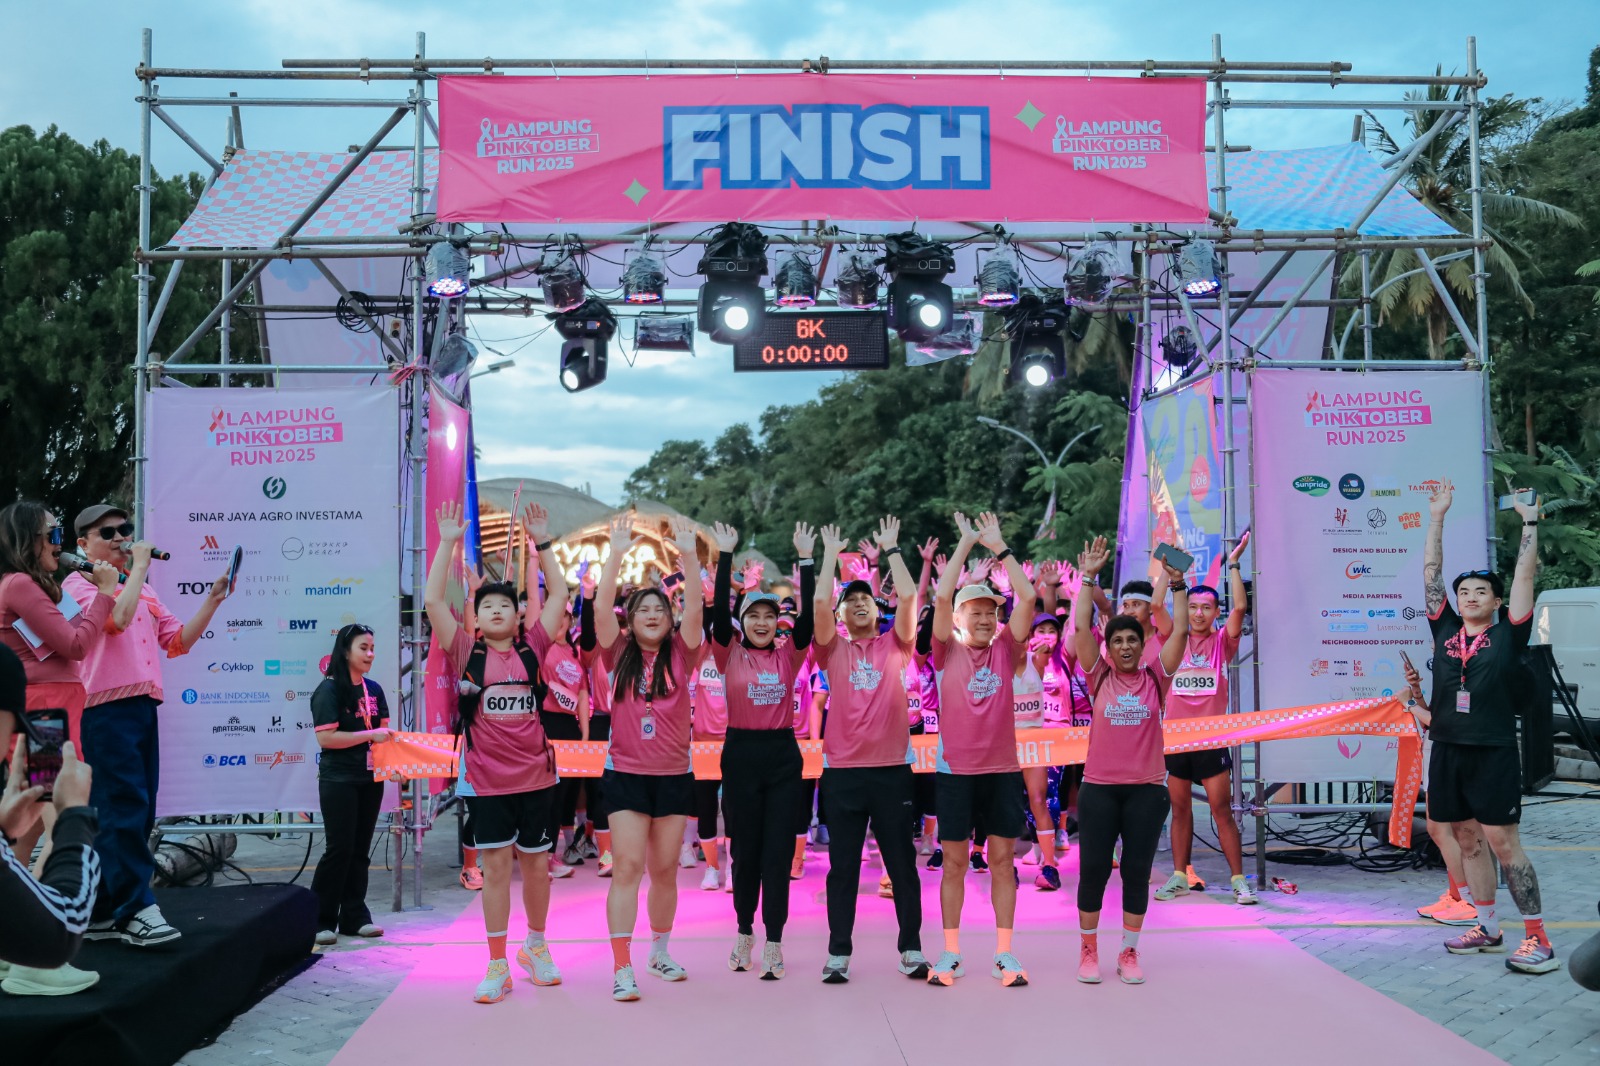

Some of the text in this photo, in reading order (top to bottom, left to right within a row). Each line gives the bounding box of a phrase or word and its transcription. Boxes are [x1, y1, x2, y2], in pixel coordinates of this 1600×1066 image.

[493, 119, 592, 139] LAMPUNG
[1068, 119, 1162, 136] LAMPUNG
[484, 137, 591, 156] PINKTOBER
[671, 111, 983, 183] FINISH
[1060, 137, 1161, 153] PINKTOBER
[497, 156, 575, 174] RUN 2025
[1073, 156, 1147, 171] RUN 2025
[796, 319, 826, 339] 6K
[762, 344, 848, 364] 0:00:00
[1321, 389, 1423, 408] LAMPUNG
[226, 406, 336, 426] LAMPUNG
[1312, 409, 1423, 426] PINKTOBER
[215, 426, 335, 447] PINKTOBER
[1326, 429, 1406, 446] RUN 2025
[230, 448, 316, 466] RUN 2025
[1191, 472, 1208, 490] Joie
[1295, 481, 1328, 489] Sunpride
[188, 510, 363, 522] SINAR JAYA AGRO INVESTAMA
[1352, 564, 1372, 574] wkc
[305, 584, 352, 596] mandiri
[226, 618, 263, 627] sakatonik
[289, 619, 318, 630] BWT
[221, 662, 254, 673] Cyklop
[1175, 677, 1215, 688] 60893
[487, 696, 534, 711] 60719
[552, 688, 575, 711] 0881
[1013, 700, 1040, 712] 0009
[1109, 704, 1148, 712] LAMPUNG
[212, 725, 256, 734] AMATERASUN
[219, 755, 247, 766] BCA
[1016, 740, 1055, 764] ART
